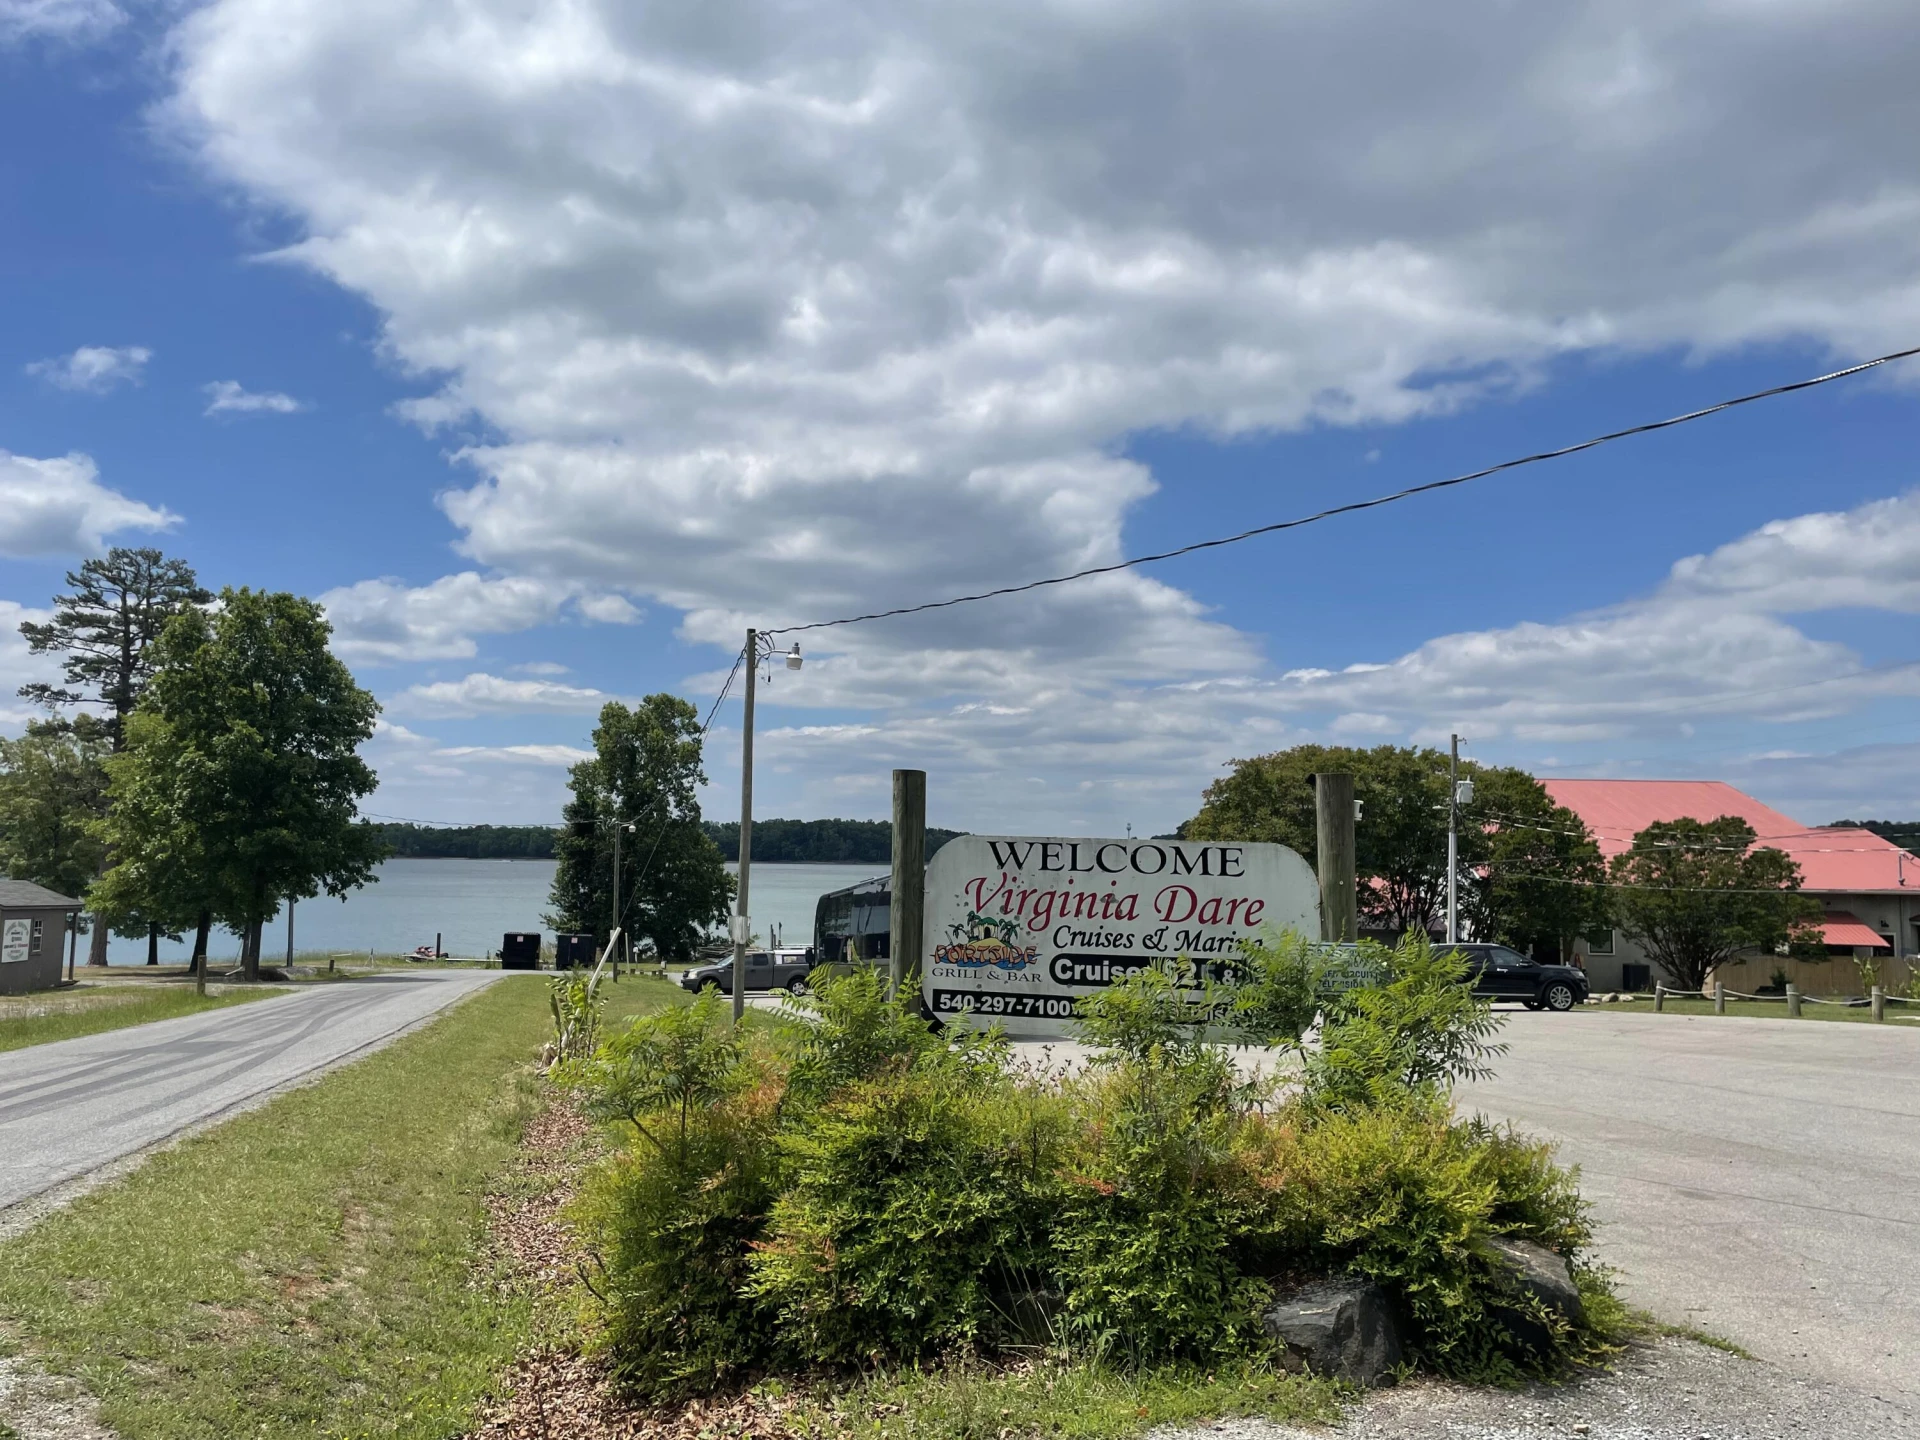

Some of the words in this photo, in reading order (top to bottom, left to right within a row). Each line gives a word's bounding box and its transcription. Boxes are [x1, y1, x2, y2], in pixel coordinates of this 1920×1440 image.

[987, 840, 1246, 878] WELCOME
[964, 871, 1140, 932] Virginia
[1154, 884, 1265, 927] Dare
[1052, 924, 1136, 949] Cruises
[1142, 925, 1169, 952] &
[934, 944, 1039, 965] PORTSIDE
[931, 967, 983, 980] GRILL
[986, 970, 1001, 981] &
[1007, 971, 1043, 983] BAR
[939, 993, 1072, 1017] 540-297-7100
